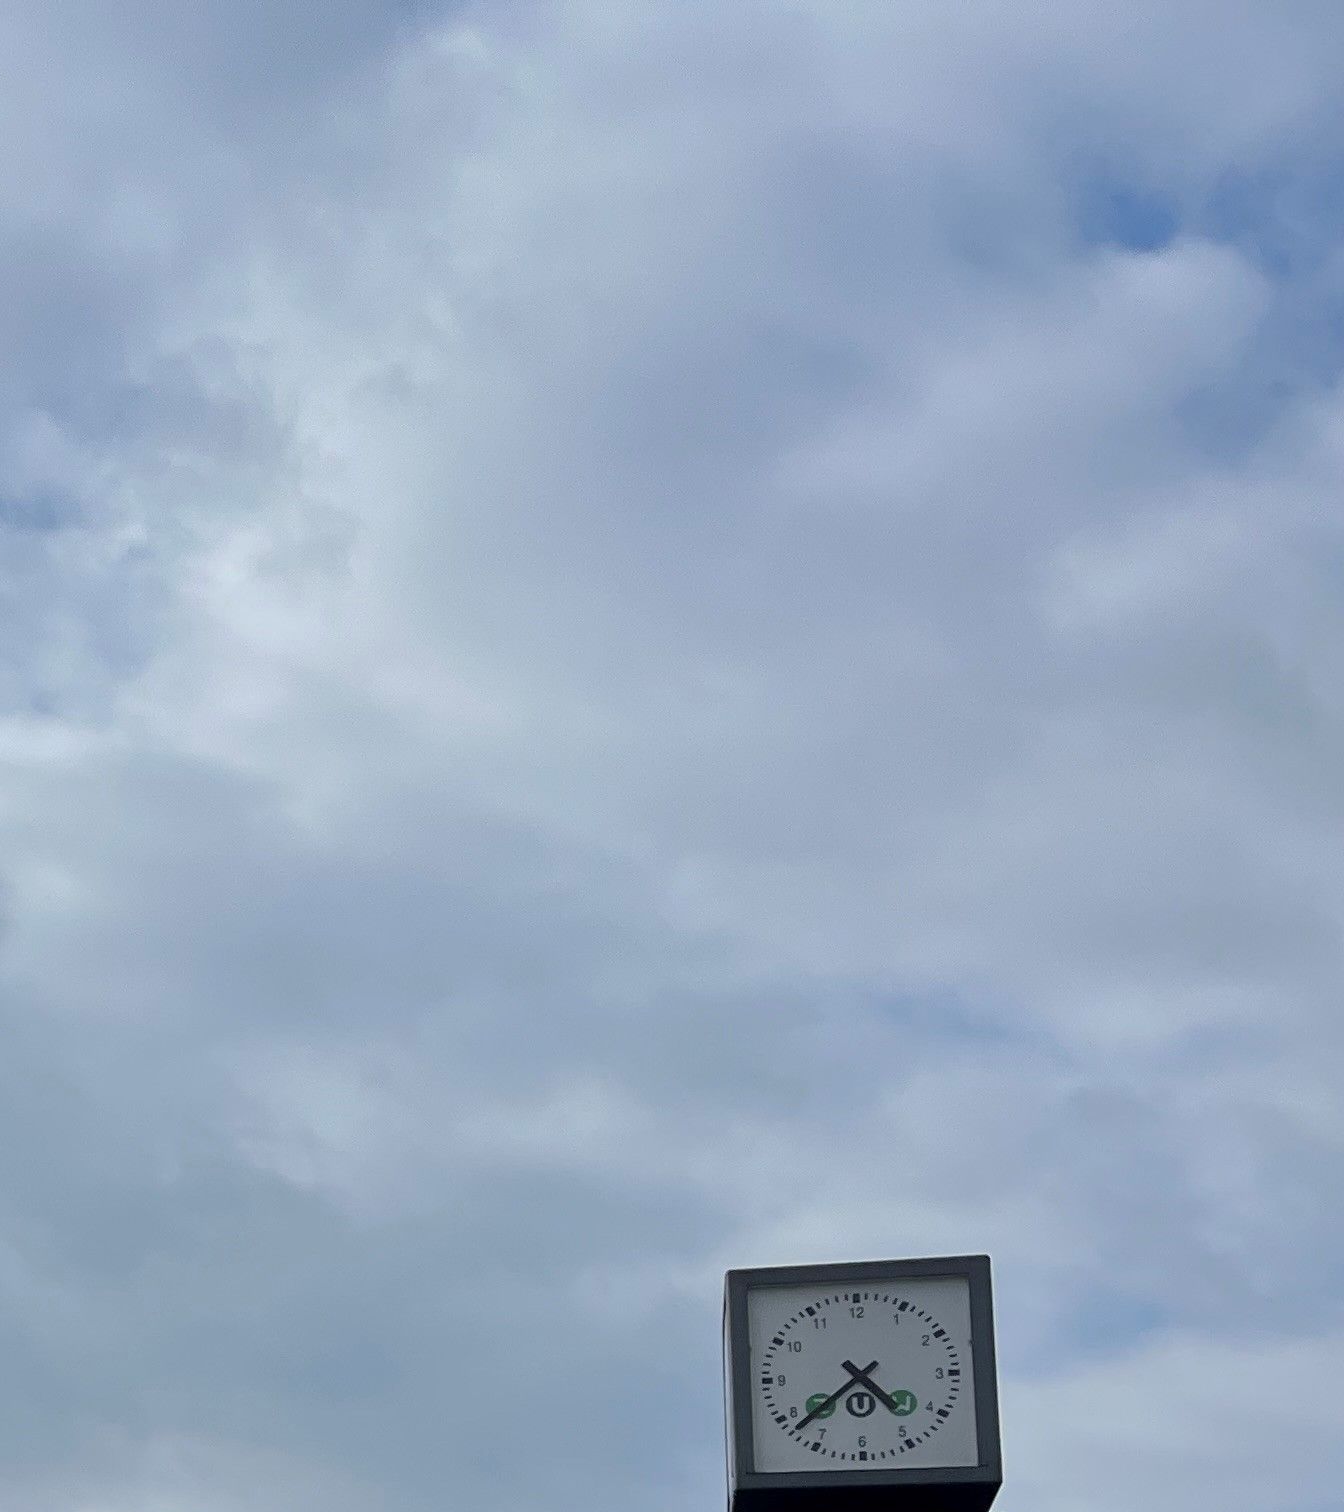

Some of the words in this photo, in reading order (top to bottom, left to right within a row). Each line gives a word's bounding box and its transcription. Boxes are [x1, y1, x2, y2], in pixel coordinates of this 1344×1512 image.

[849, 1306, 865, 1319] 12
[814, 1317, 827, 1330] 11
[893, 1313, 900, 1326] 1
[787, 1340, 802, 1353] 10
[921, 1334, 930, 1347] 2
[935, 1367, 944, 1380] 3
[777, 1375, 786, 1387] 9
[789, 1406, 798, 1419] 8
[925, 1400, 934, 1413] 4
[818, 1428, 827, 1440] 7
[898, 1425, 907, 1438] 5
[858, 1435, 867, 1448] 6
